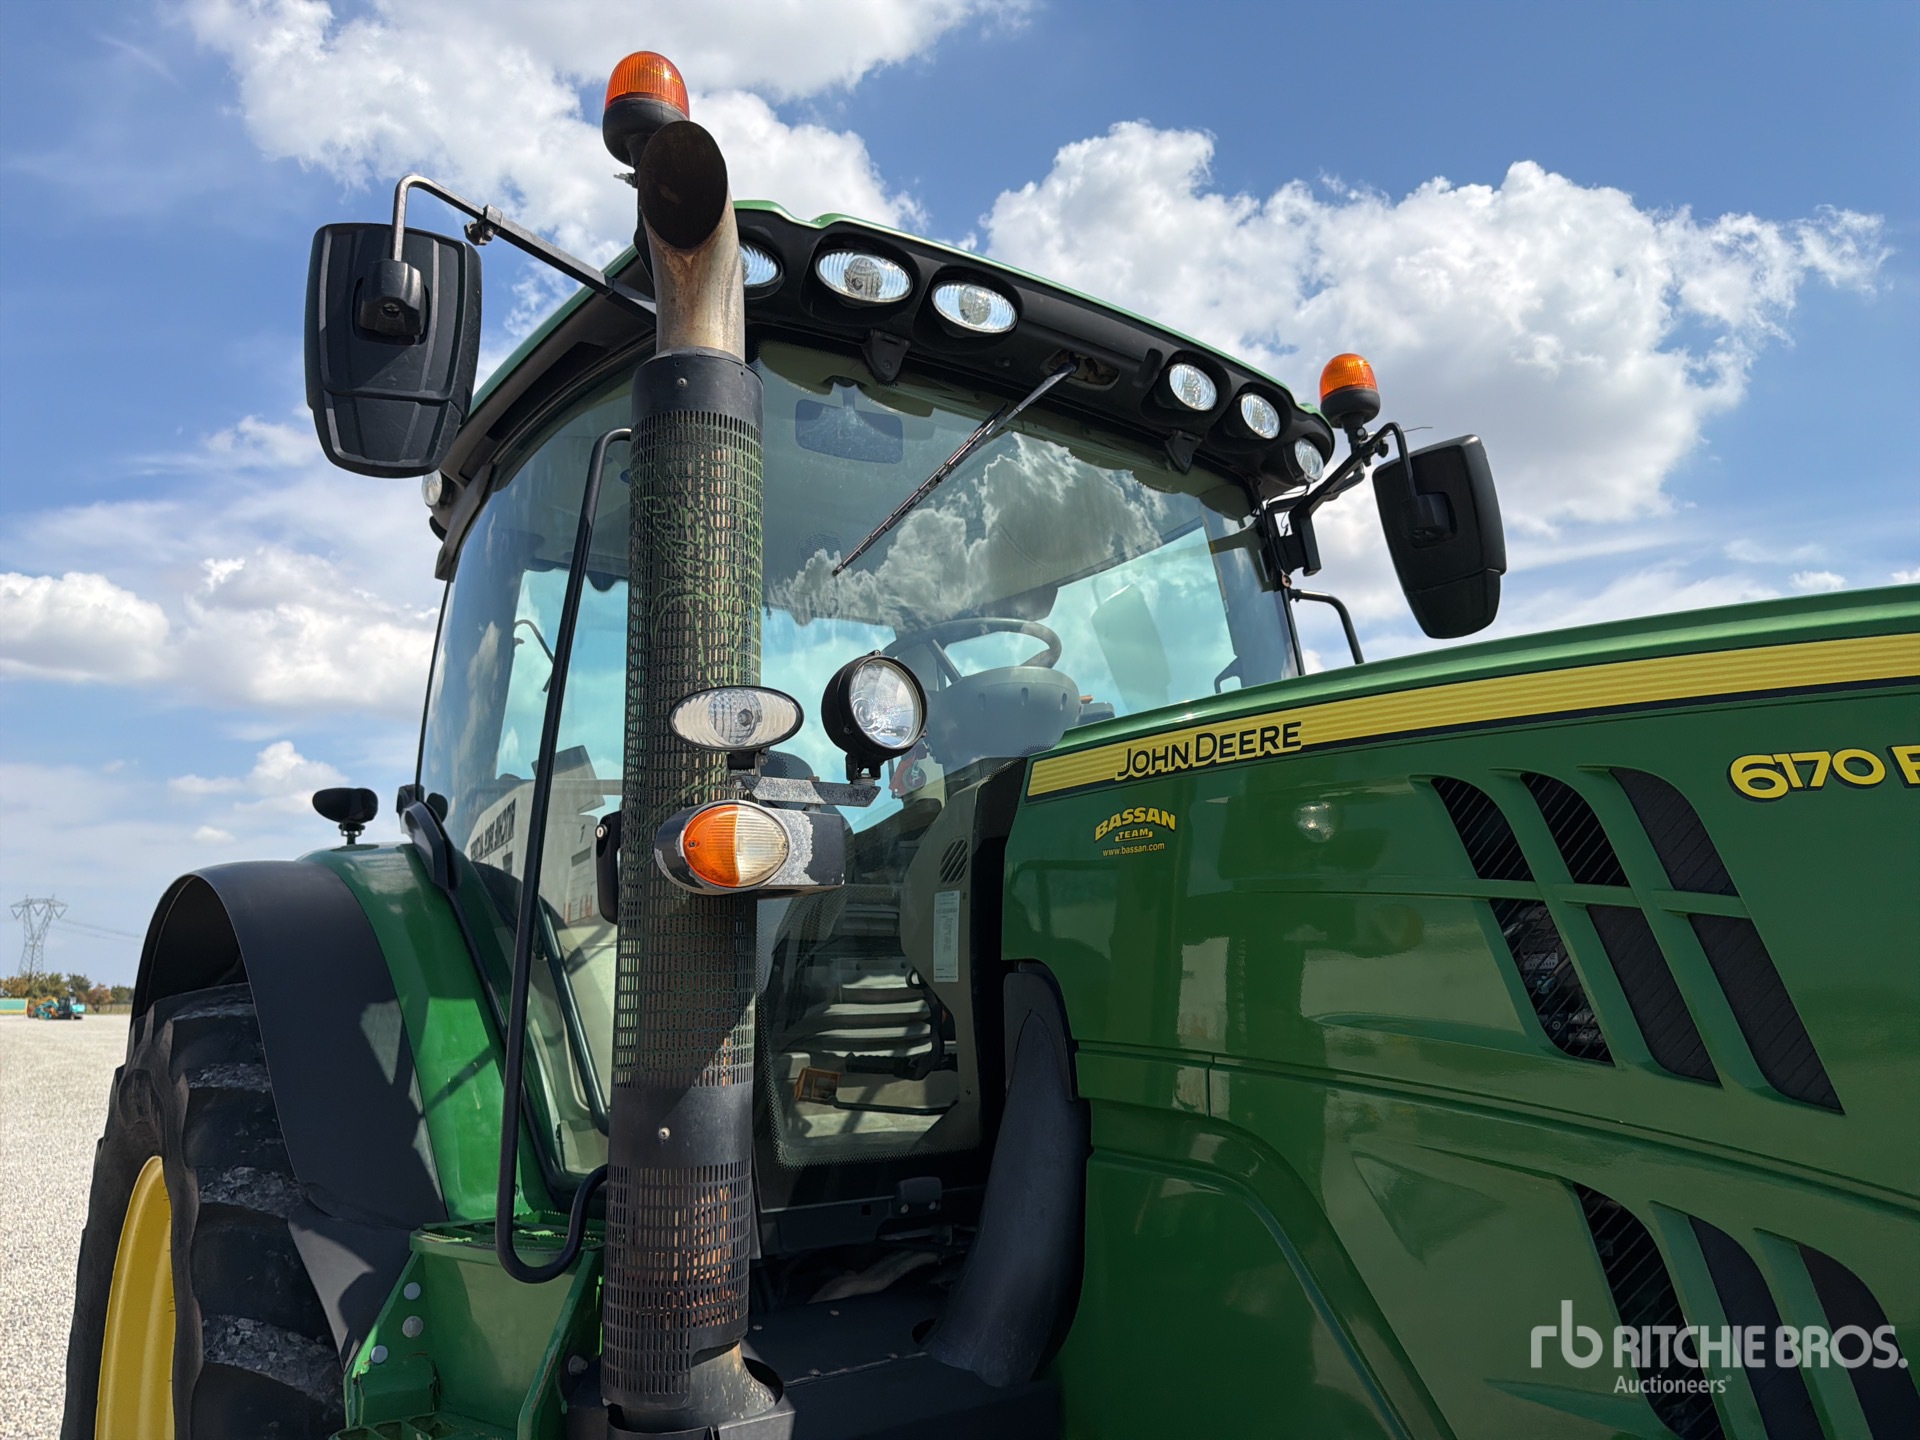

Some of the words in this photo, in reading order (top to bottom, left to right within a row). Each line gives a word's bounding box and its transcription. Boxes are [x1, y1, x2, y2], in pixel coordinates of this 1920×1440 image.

[1117, 741, 1189, 777] JOHN
[1195, 721, 1302, 763] DEERE
[1094, 806, 1177, 842] BASSAN
[1118, 827, 1149, 840] TEAM
[1102, 842, 1166, 857] www.bassan.com
